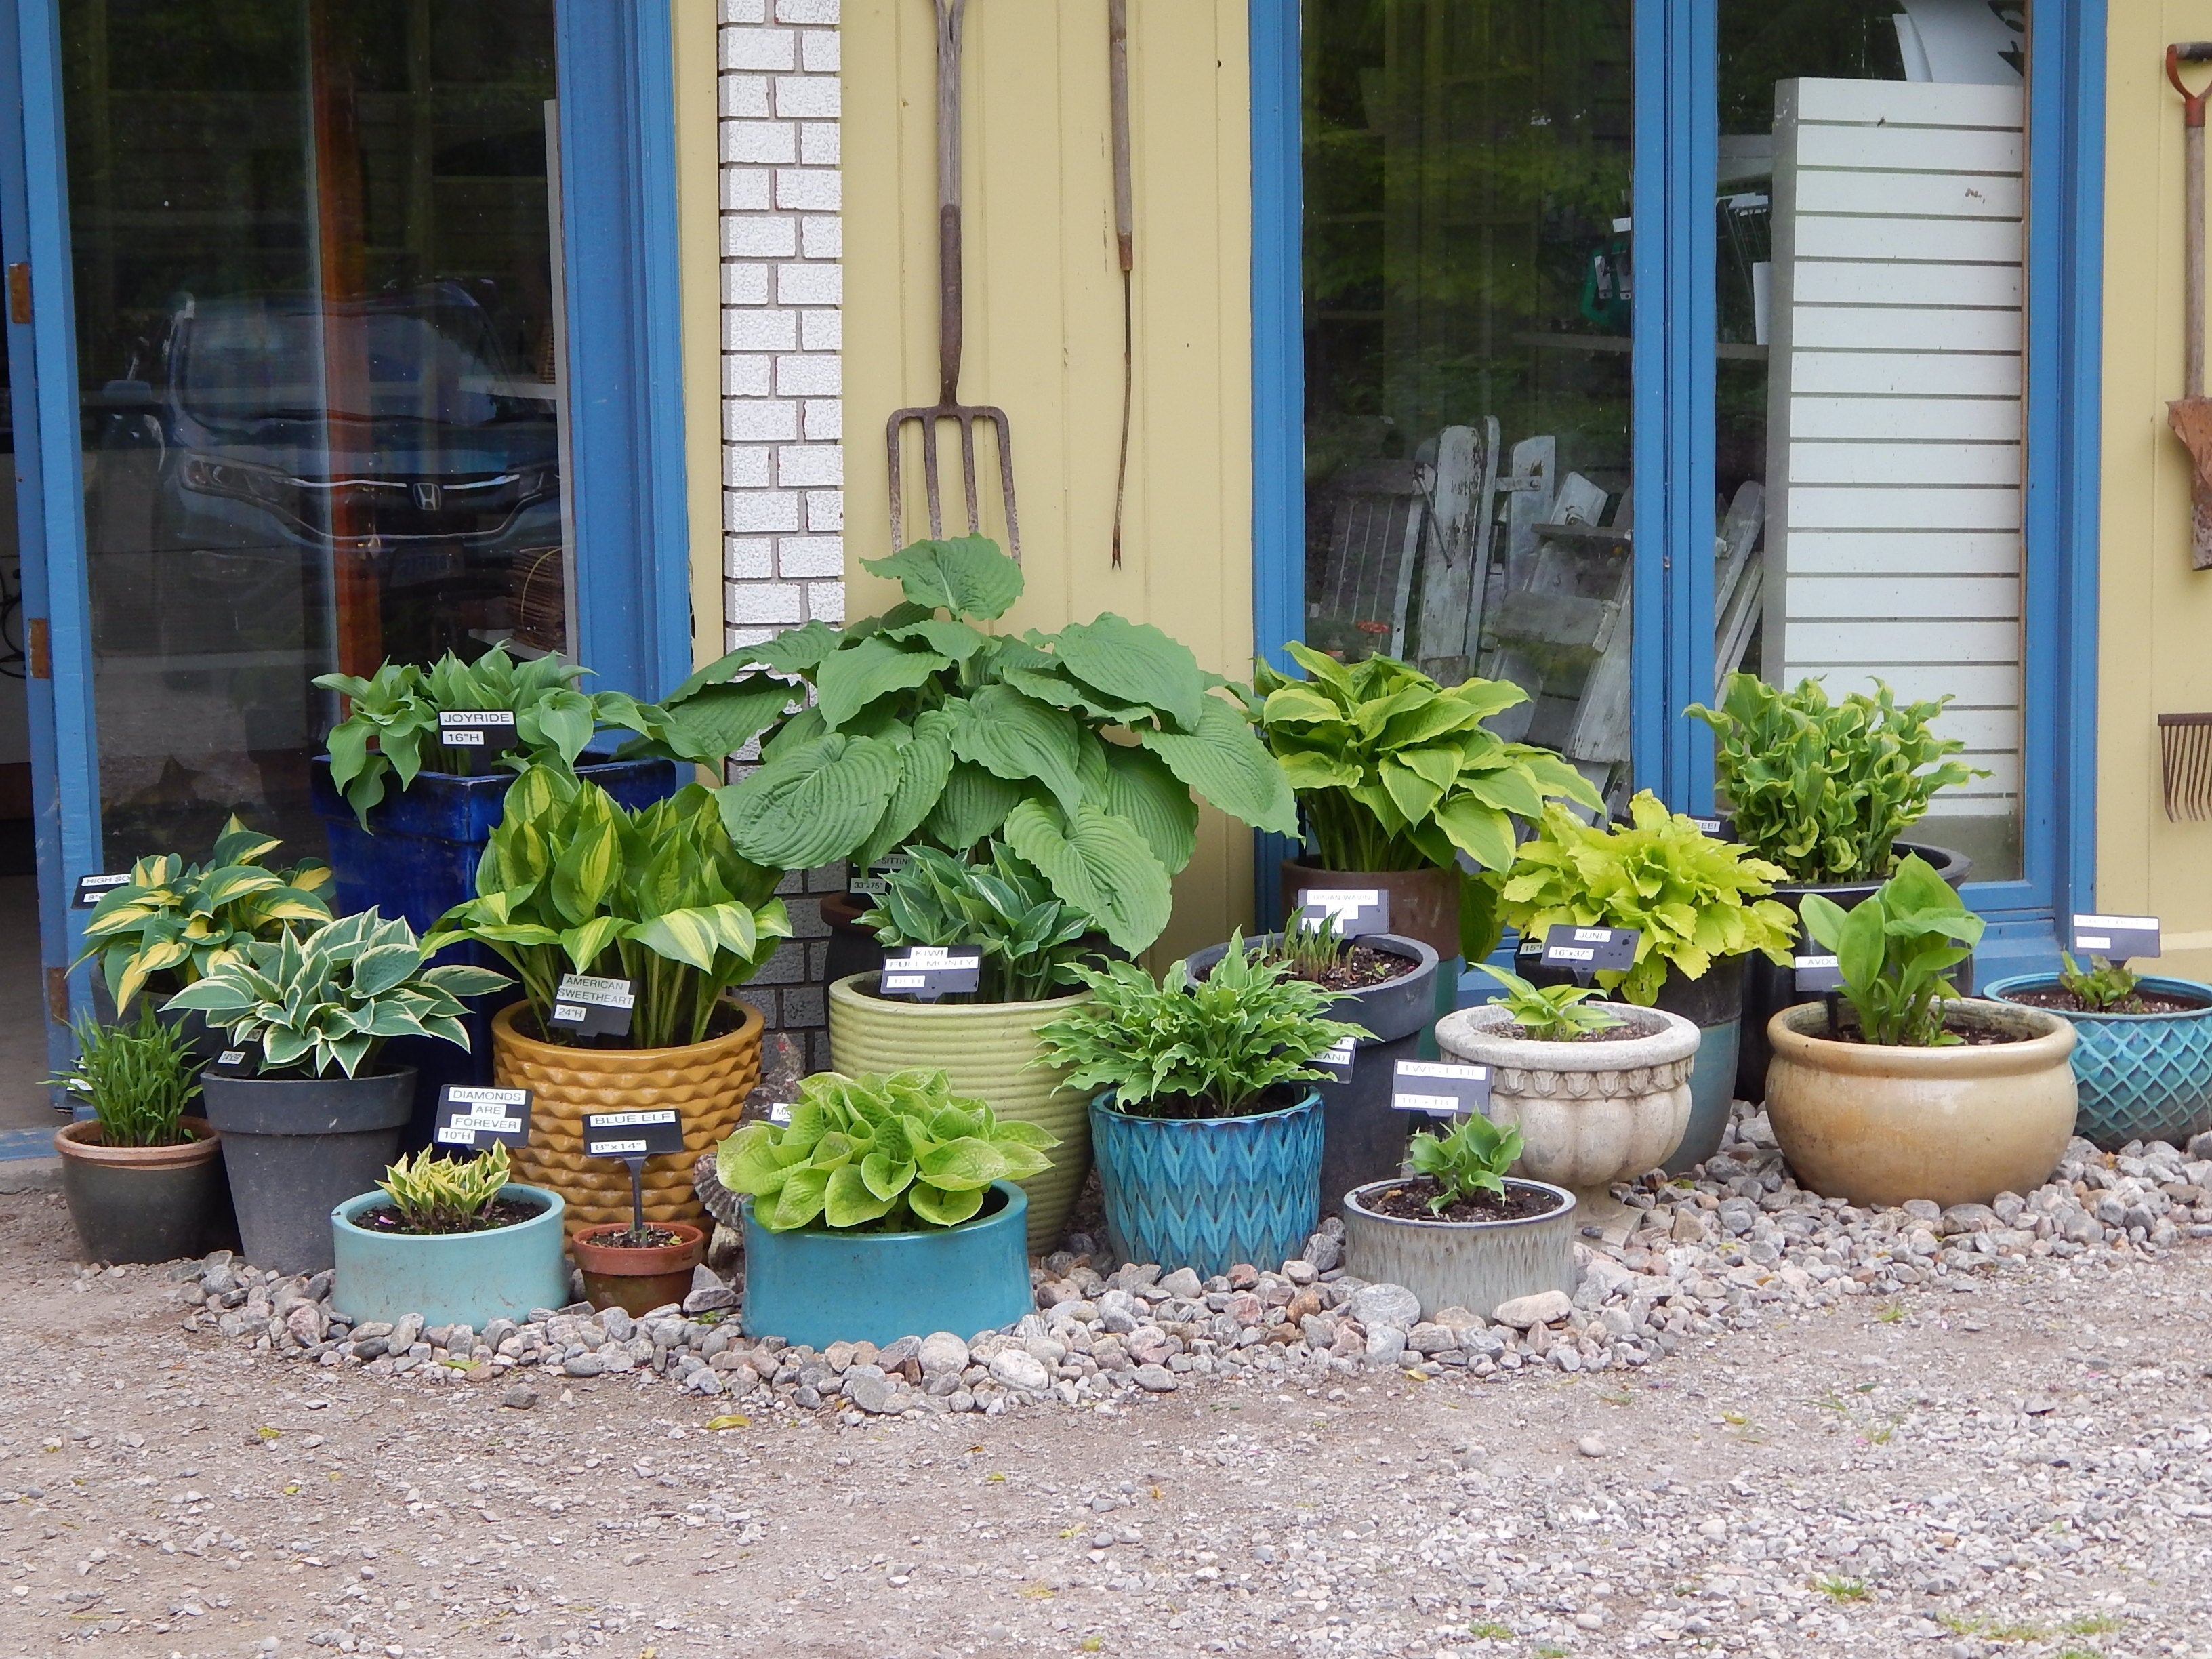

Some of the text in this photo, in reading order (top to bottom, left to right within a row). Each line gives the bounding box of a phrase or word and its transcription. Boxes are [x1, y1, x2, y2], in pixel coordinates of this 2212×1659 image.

[445, 714, 510, 723] JOYRIDE
[448, 733, 480, 742] 16"H
[86, 876, 112, 884] HIGH
[1553, 949, 1591, 958] 16"x37"
[566, 977, 624, 991] AMERICAN
[557, 987, 633, 1005] SWEETHEART
[558, 1008, 583, 1018] 24"H
[453, 1090, 522, 1102] DIAMONDS
[475, 1105, 502, 1115] ARE
[455, 1118, 517, 1129] FOREVER
[595, 1113, 672, 1124] BLUE ELF
[444, 1130, 471, 1141] 10"H
[595, 1143, 642, 1151] 8"x14"
